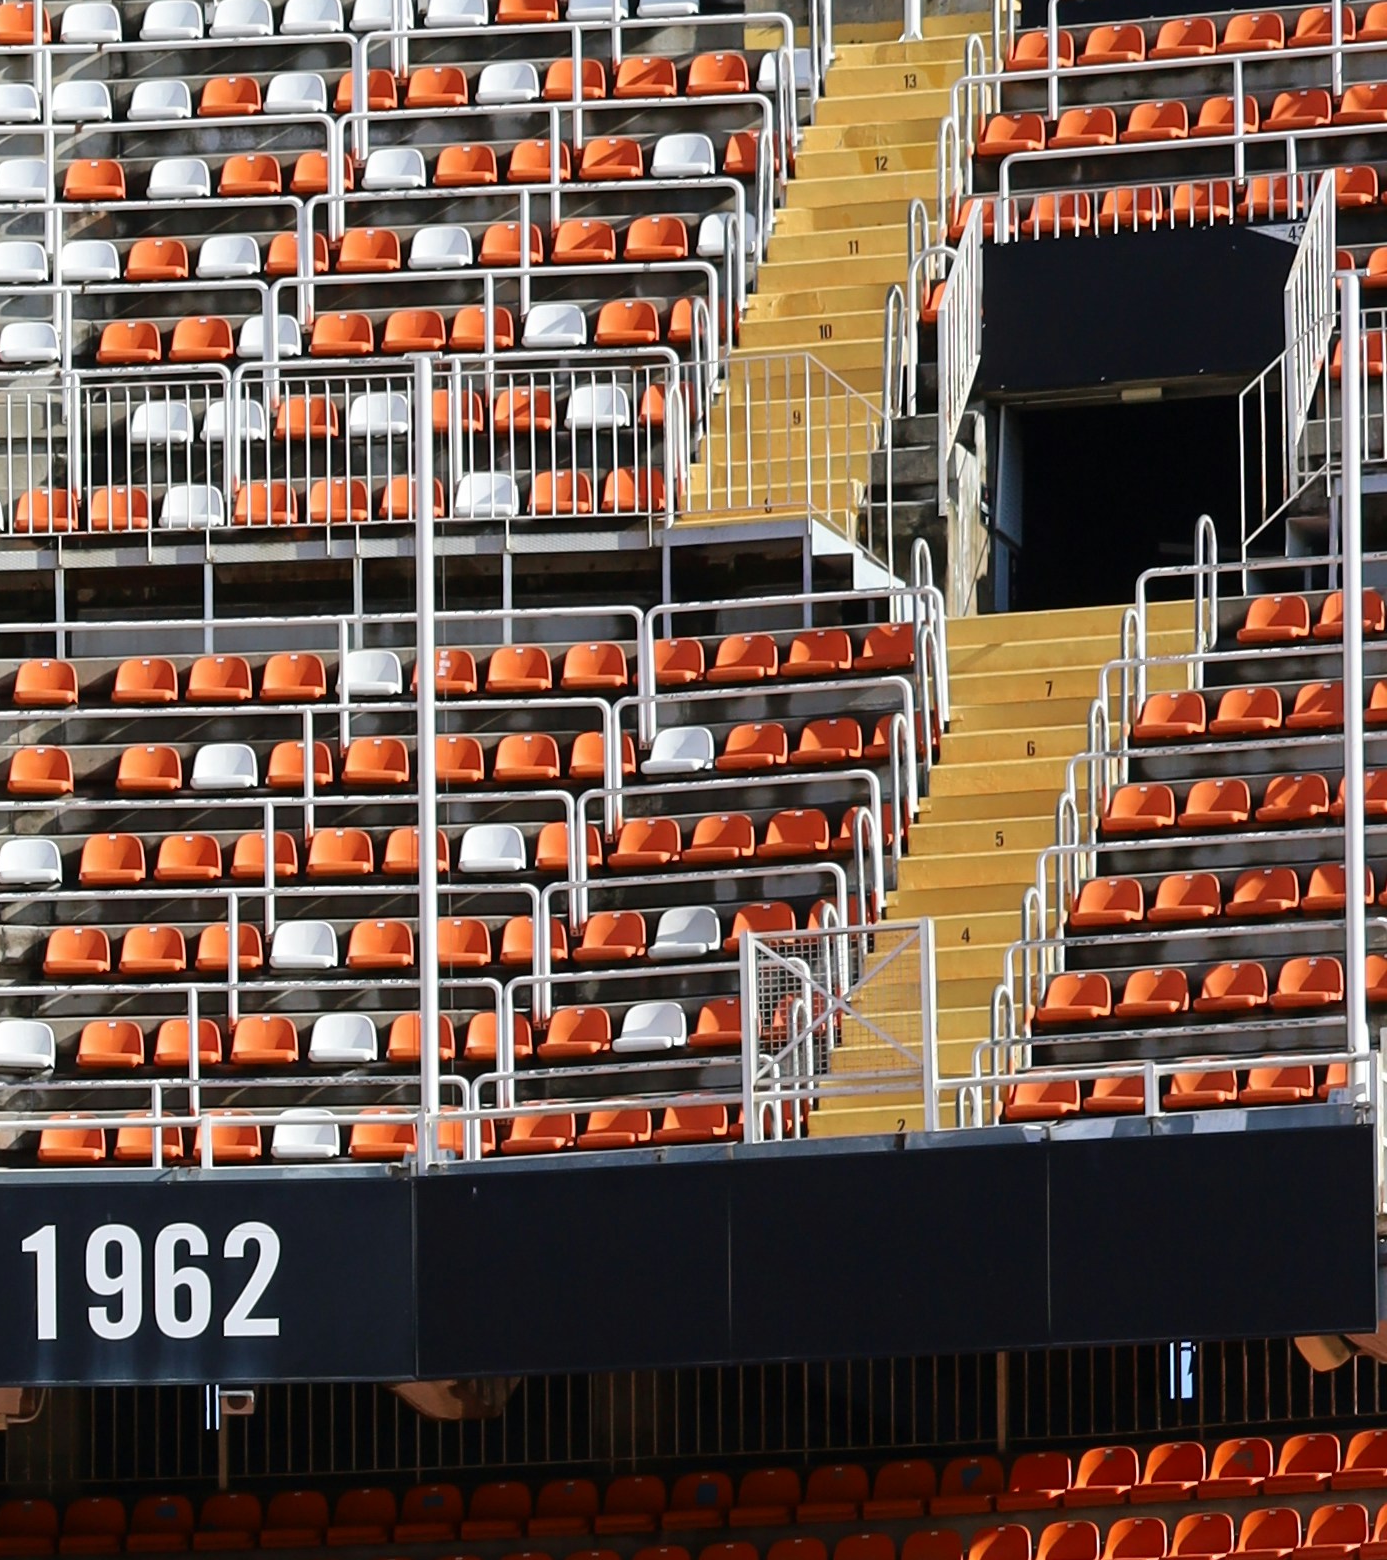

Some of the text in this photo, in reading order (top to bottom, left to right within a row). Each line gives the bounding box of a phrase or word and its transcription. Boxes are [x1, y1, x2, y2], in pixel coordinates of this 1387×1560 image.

[903, 74, 917, 89] 13
[874, 156, 888, 171] 12
[847, 240, 859, 255] 11
[818, 324, 832, 340] 10
[793, 410, 802, 426] 9
[1045, 681, 1054, 697] 7
[1026, 741, 1036, 757] 6
[995, 831, 1004, 848] 5
[961, 928, 971, 944] 4
[897, 1119, 906, 1133] 2
[21, 1221, 281, 1340] 1962
